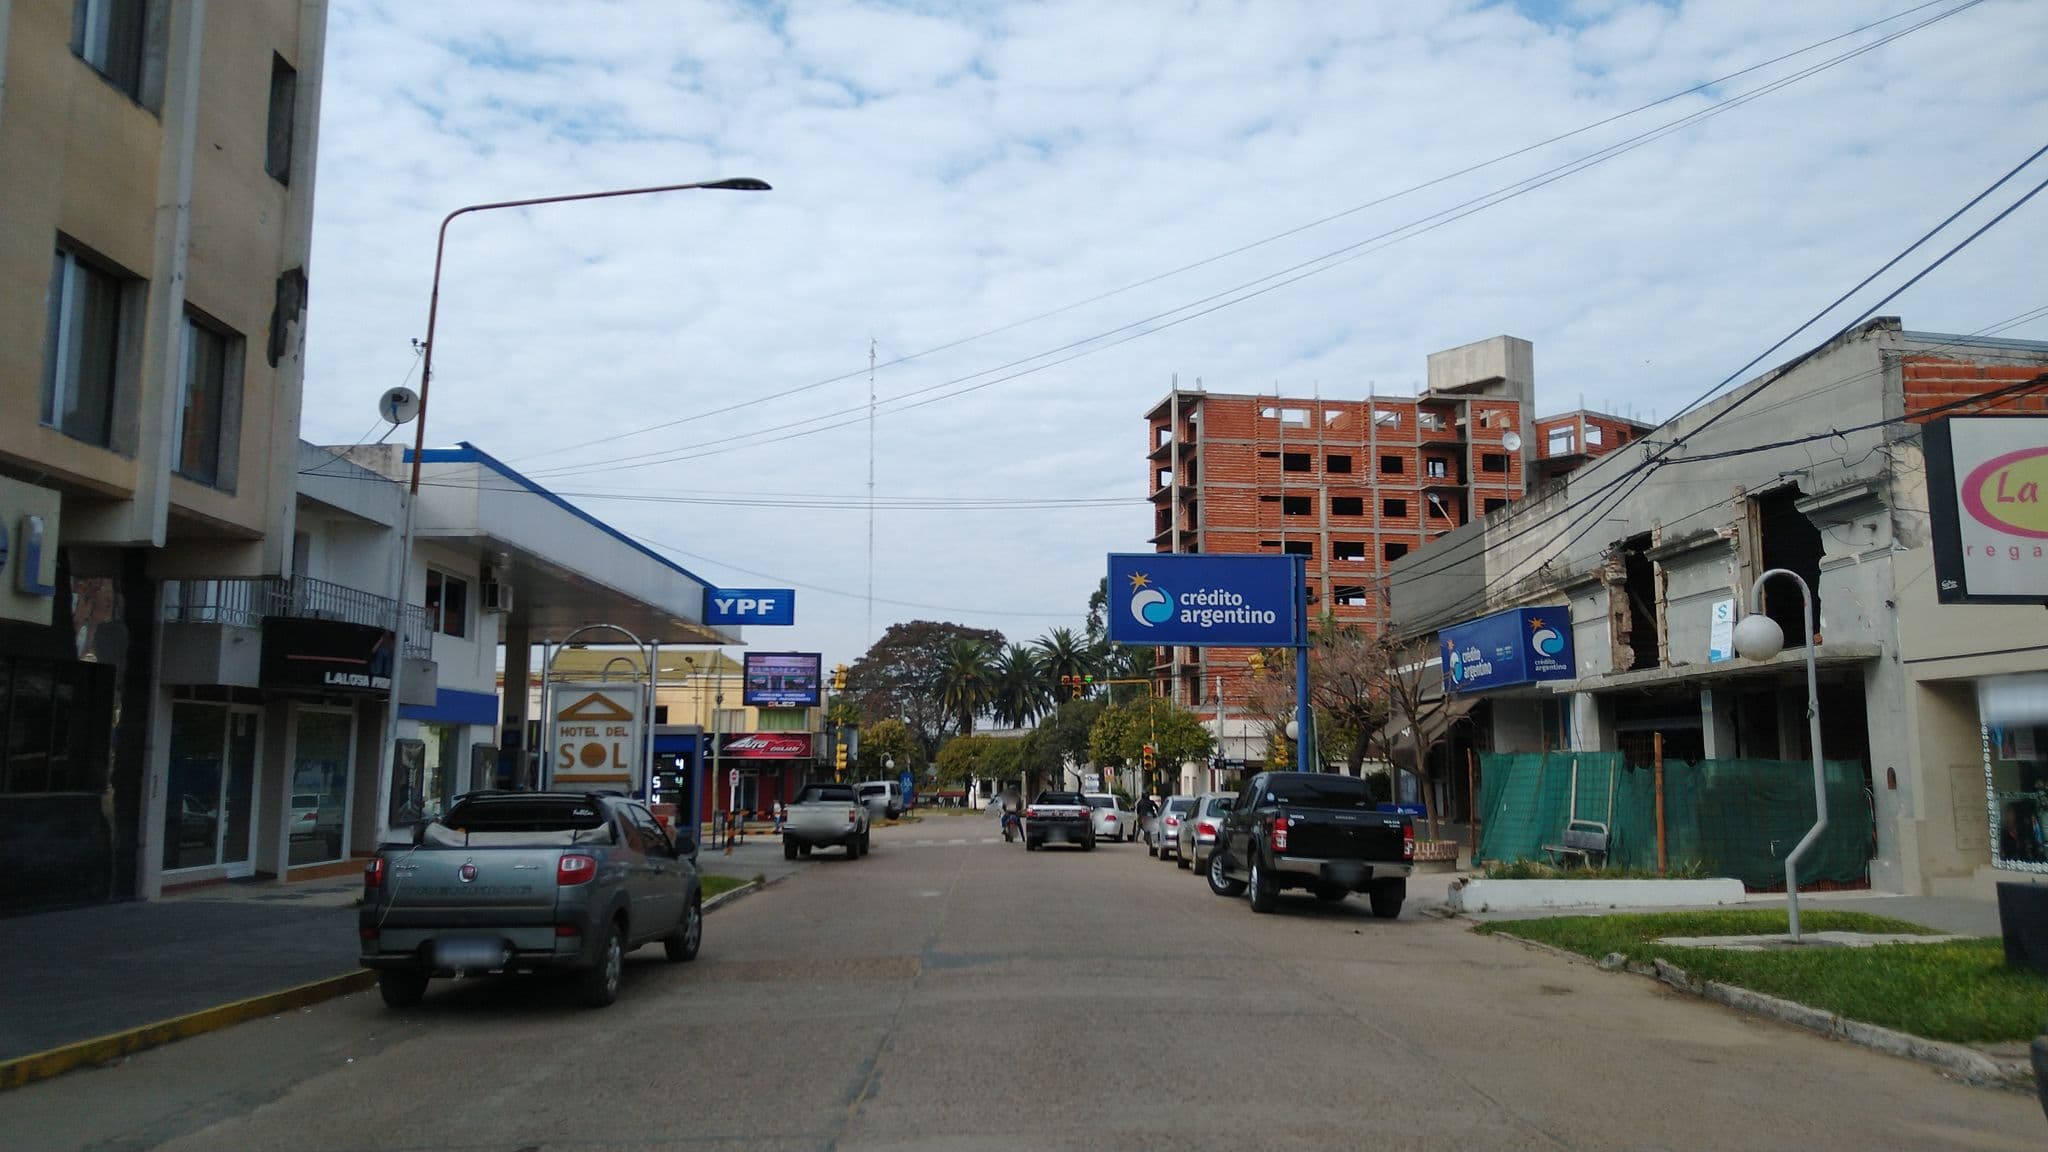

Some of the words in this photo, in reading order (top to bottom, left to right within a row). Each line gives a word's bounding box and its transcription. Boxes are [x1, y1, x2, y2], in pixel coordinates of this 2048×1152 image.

[1996, 471, 2040, 503] La
[714, 598, 775, 615] YPF
[1180, 588, 1243, 606] crédito
[1180, 605, 1276, 627] argentino
[1461, 646, 1481, 664] crédito
[1463, 659, 1492, 681] argentino
[560, 726, 599, 737] HOTEL
[606, 726, 629, 737] DEL
[558, 742, 628, 769] SOL
